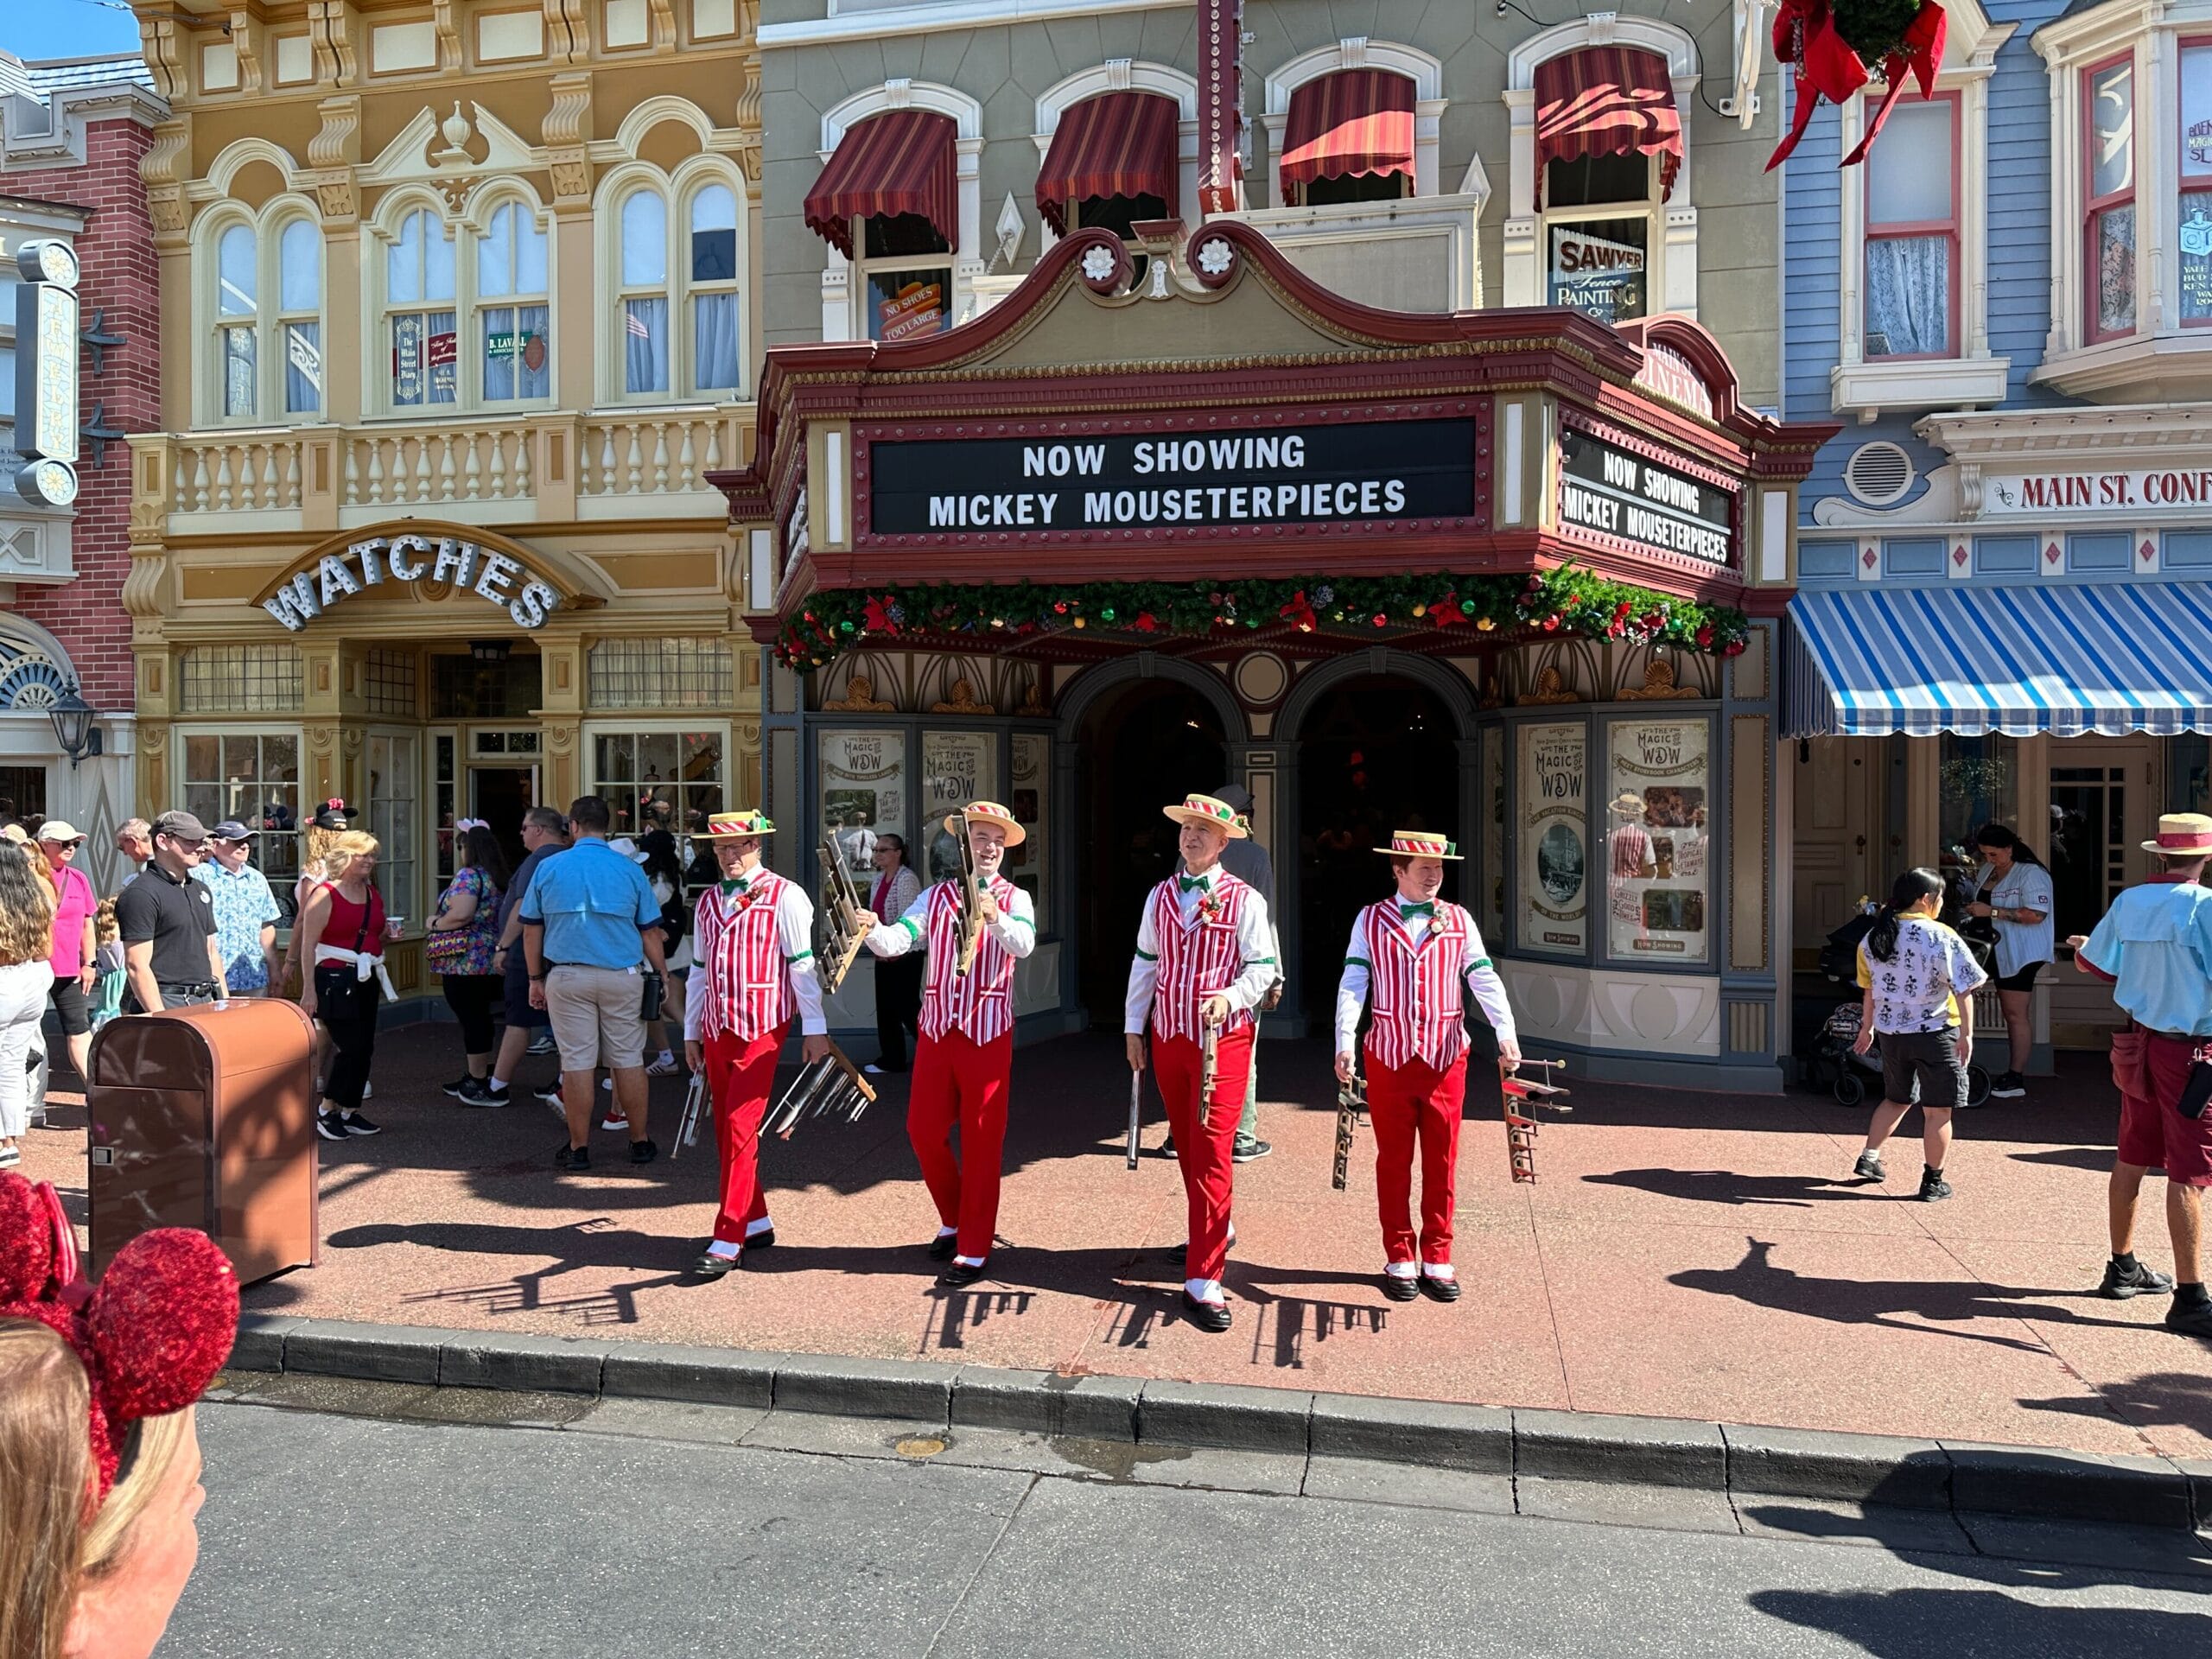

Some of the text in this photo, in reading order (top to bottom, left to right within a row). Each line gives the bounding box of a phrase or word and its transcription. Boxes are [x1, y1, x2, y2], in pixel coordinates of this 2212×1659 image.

[1560, 240, 1643, 273] SAWYER
[1571, 274, 1624, 289] Fence
[886, 287, 933, 318] NO SHOES
[1557, 283, 1637, 307] PAINTING
[885, 310, 939, 341] TOO LARGE
[403, 337, 414, 346] The
[489, 336, 527, 349] B. LAVL
[400, 359, 416, 369] Street
[1652, 342, 1680, 373] MAIN
[47, 295, 67, 450] JEWELRY
[400, 370, 416, 381] Diary
[1022, 435, 1306, 478] NOW SHOWING
[1604, 450, 1700, 514] NOW SHOWING
[2020, 476, 2093, 509] MAIN
[2100, 474, 2136, 505] ST.
[929, 479, 1407, 528] MICKEY MOUSETERPIECES
[1564, 486, 1727, 563] MICKEY MOUSETERPIECES
[263, 534, 561, 632] WATCHES
[946, 751, 961, 760] THE
[1554, 745, 1568, 753] THE
[1641, 747, 1681, 765] WDW
[849, 753, 881, 771] WDW
[925, 757, 964, 777] MAGIC
[1535, 752, 1573, 773] MAGIC
[931, 776, 975, 800] WDW
[1540, 772, 1582, 798] WDW
